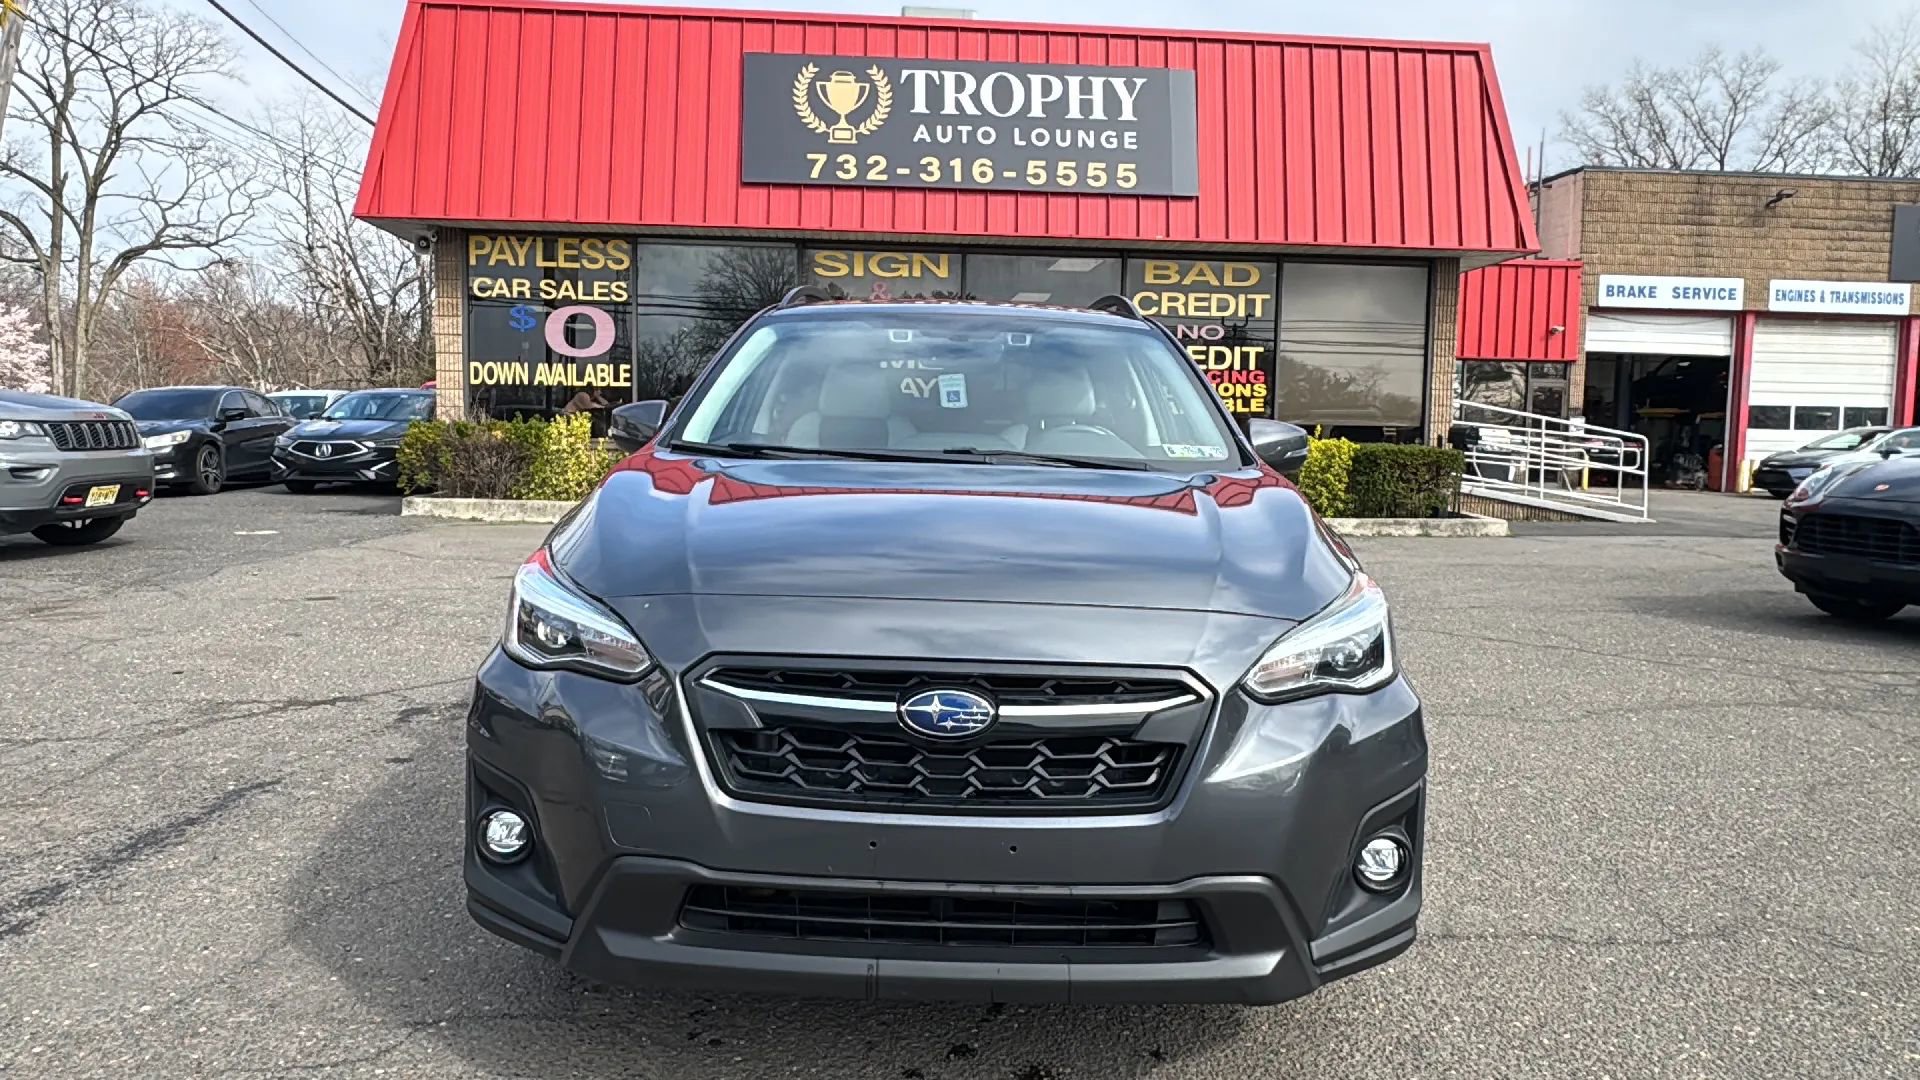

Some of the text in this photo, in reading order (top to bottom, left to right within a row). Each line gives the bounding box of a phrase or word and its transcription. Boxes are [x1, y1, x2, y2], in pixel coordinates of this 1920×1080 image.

[900, 69, 1147, 121] TROPHY
[913, 124, 1138, 149] AUTO LOUNGE
[806, 153, 1138, 188] 732-316-5555
[469, 235, 631, 271] PAYLESS
[813, 252, 949, 278] SIGN
[1144, 260, 1261, 287] BAD
[472, 277, 628, 302] CAR SALES
[1606, 285, 1737, 300] BRAKE SERVICE
[1775, 289, 1905, 305] ENGINES & TRANSMISSIONS
[1132, 291, 1271, 317] CREDIT
[1177, 324, 1225, 340] NO
[1186, 345, 1264, 370] EDIT
[469, 361, 632, 387] DOWN AVAILABLE
[1206, 370, 1265, 384] CING
[1223, 398, 1265, 412] BLE
